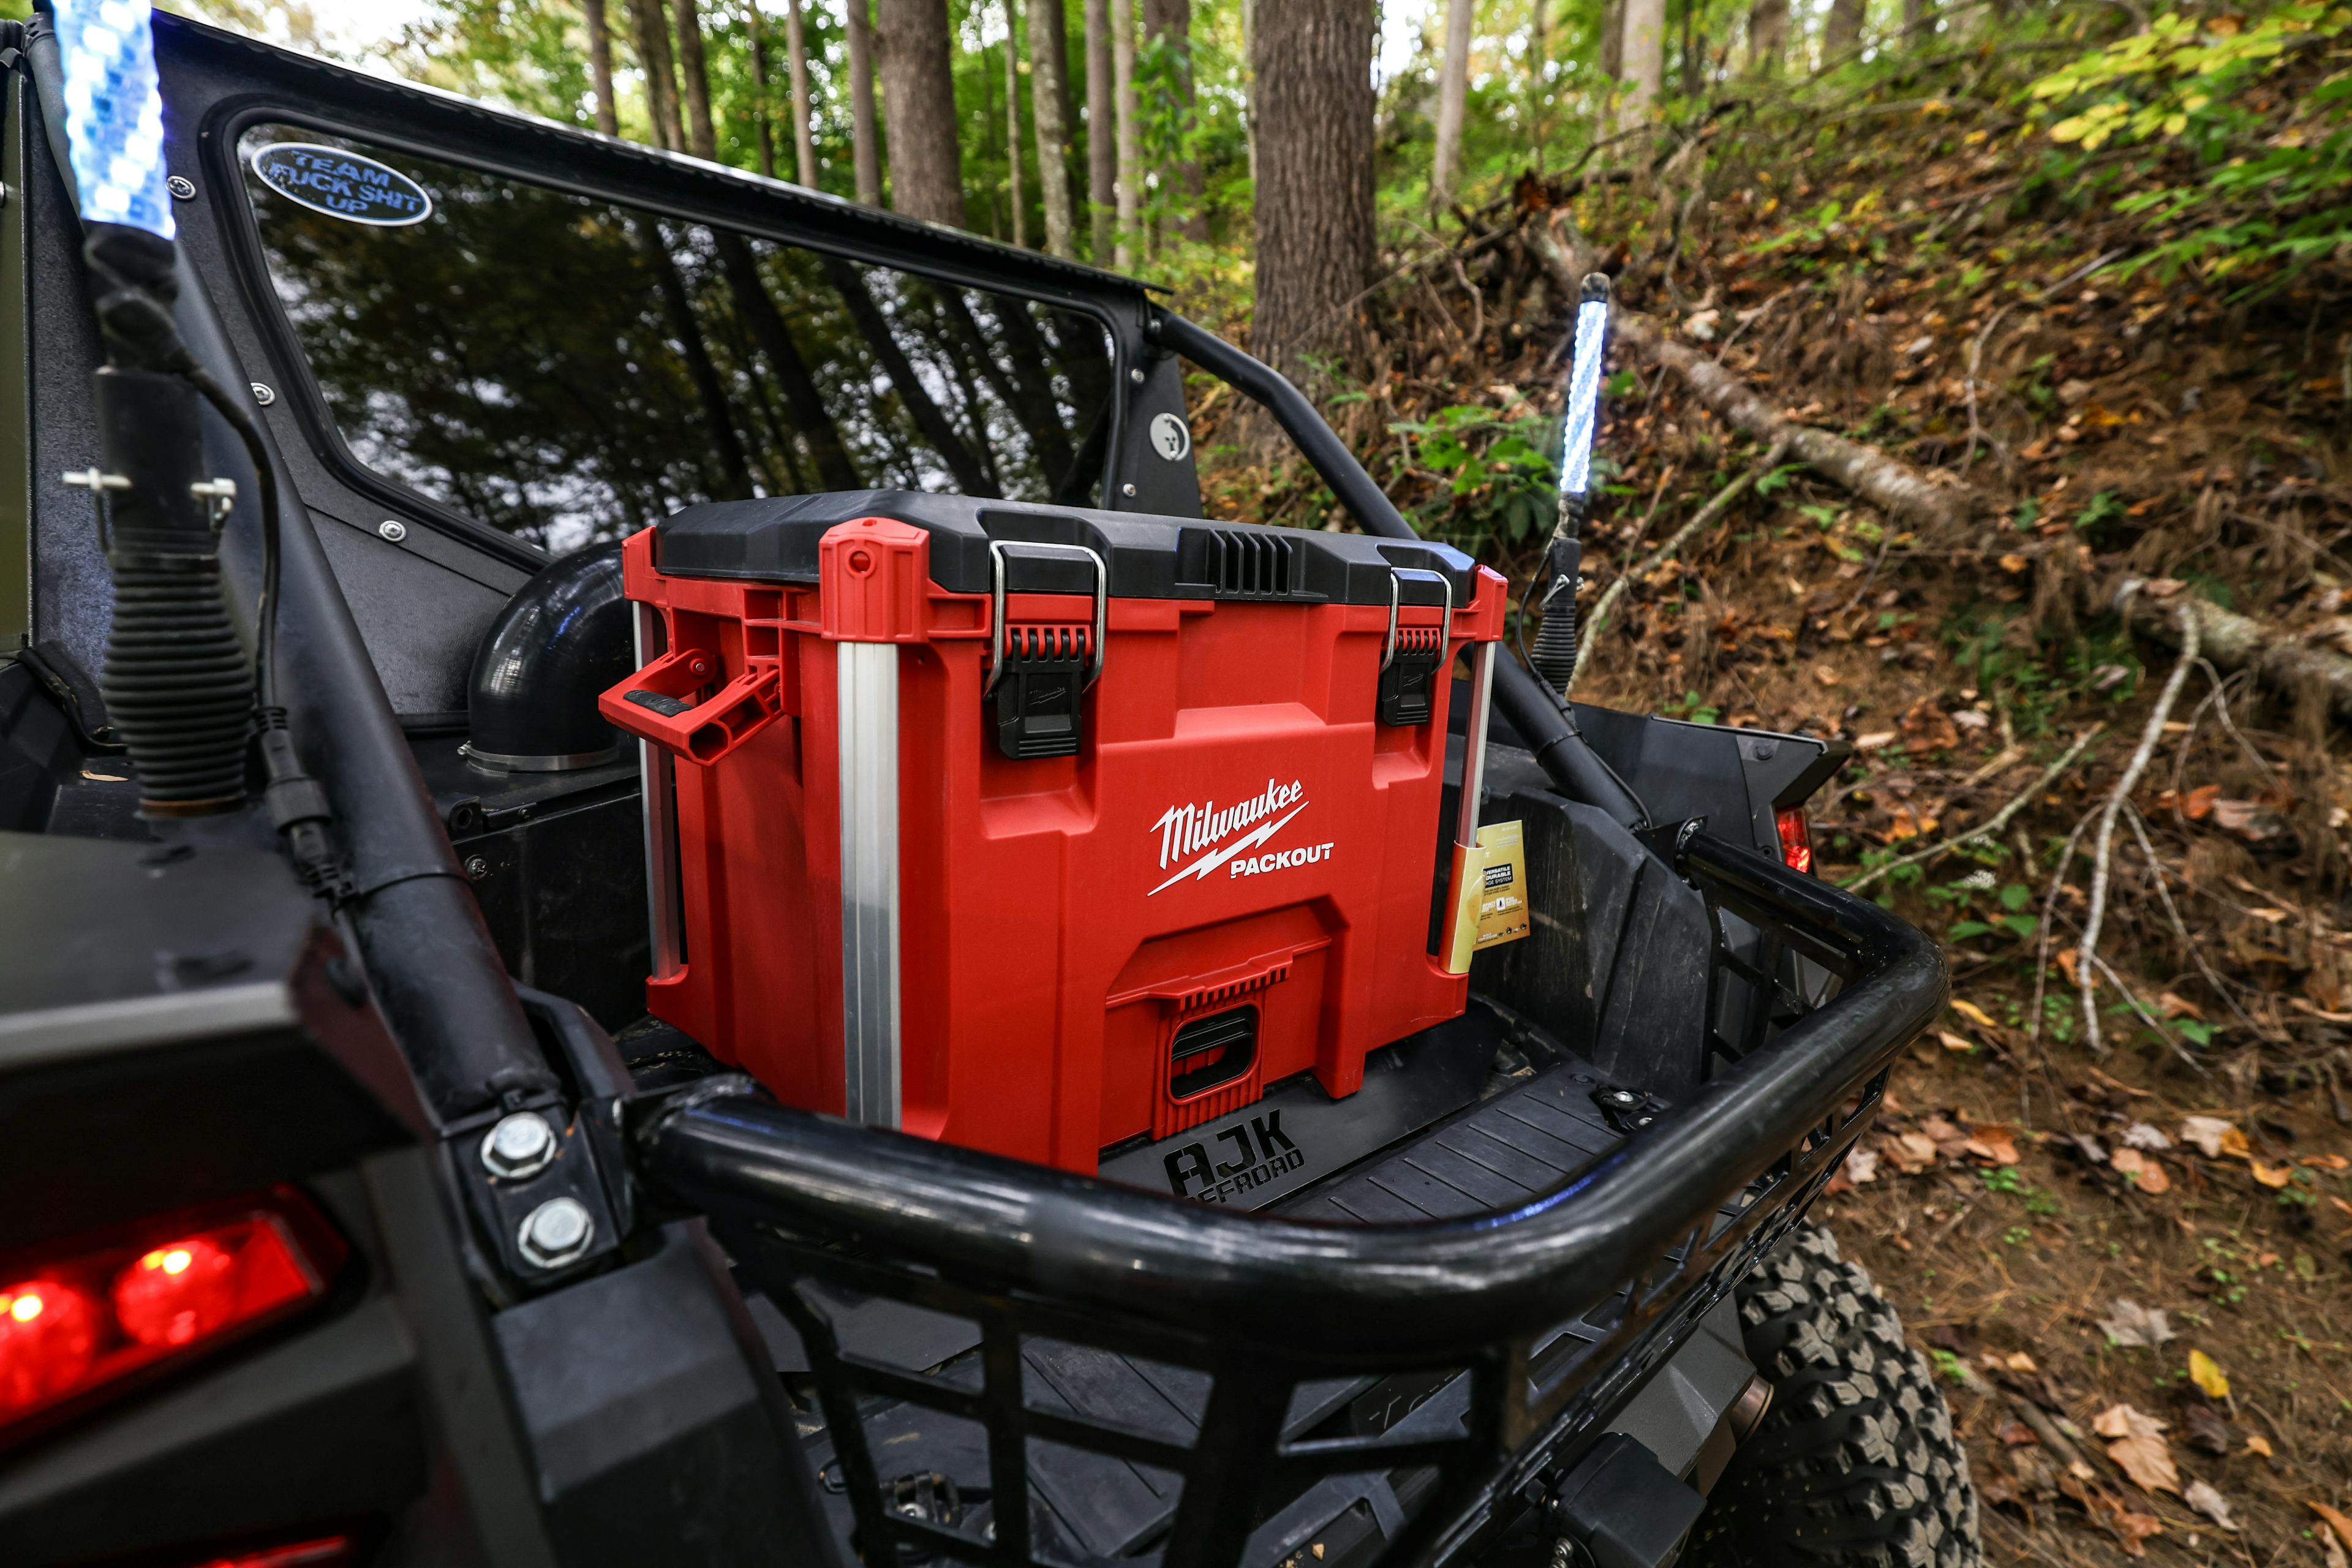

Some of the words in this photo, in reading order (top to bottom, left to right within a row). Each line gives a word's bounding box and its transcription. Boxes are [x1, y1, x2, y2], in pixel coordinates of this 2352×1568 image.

[270, 162, 353, 197] FUCK
[359, 186, 421, 211] SHIT
[292, 150, 390, 187] TEAM
[326, 194, 369, 212] UP
[1150, 778, 1303, 870] Milwaukee
[1231, 842, 1334, 879] PACKOUT
[1164, 1109, 1295, 1196] AJK
[1186, 1148, 1305, 1203] FFROAD
